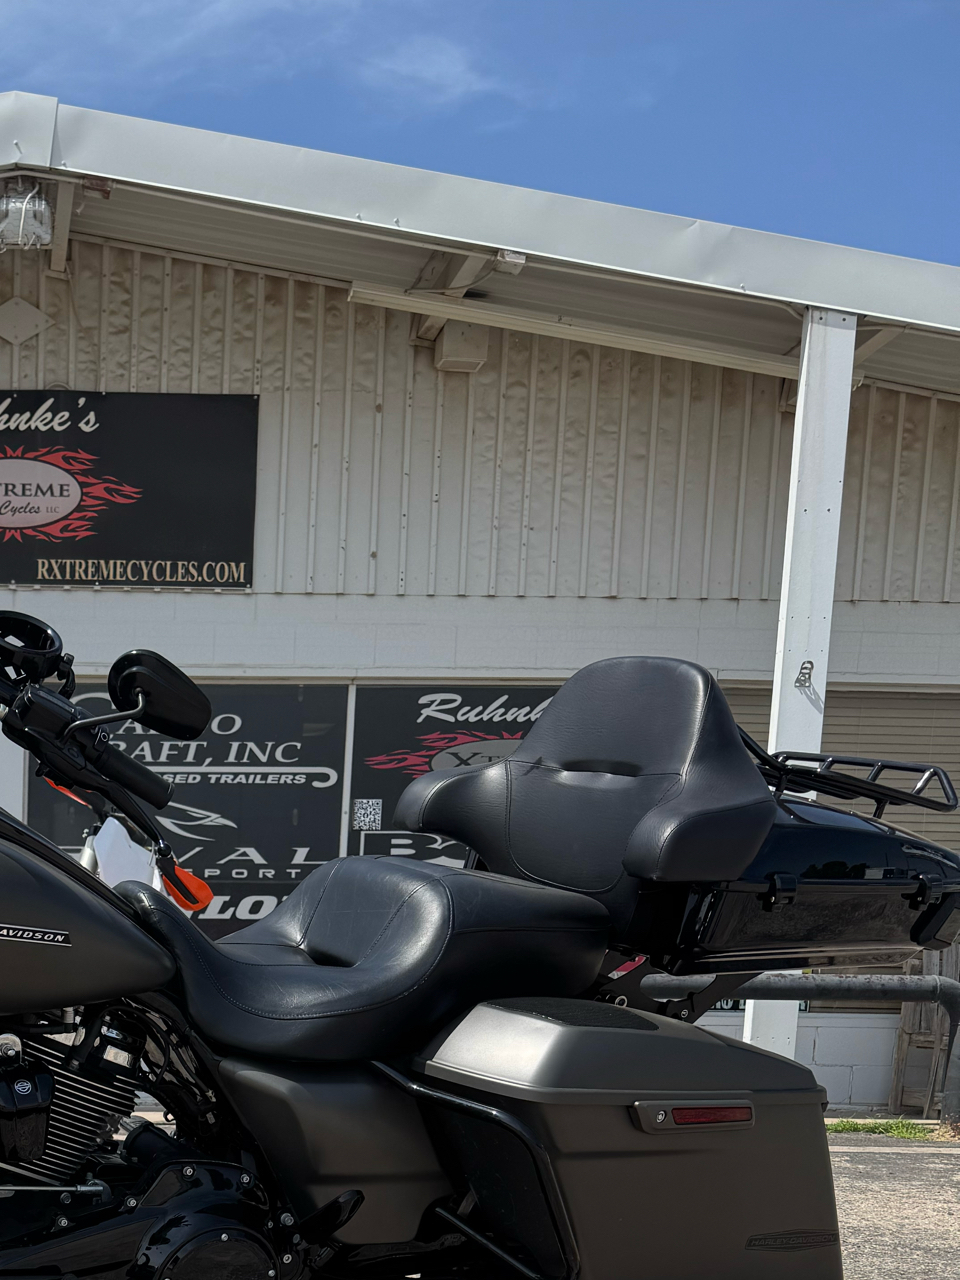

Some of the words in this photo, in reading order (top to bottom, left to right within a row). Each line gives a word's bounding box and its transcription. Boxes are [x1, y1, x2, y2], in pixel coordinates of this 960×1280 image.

[46, 506, 60, 514] LLC
[36, 558, 246, 584] RXTREMECYCLES.COM
[224, 741, 301, 763] INC
[208, 774, 307, 784] TRAILERS
[183, 868, 301, 879] PORT
[751, 1235, 836, 1247] HARLEY-DAVIDSON
